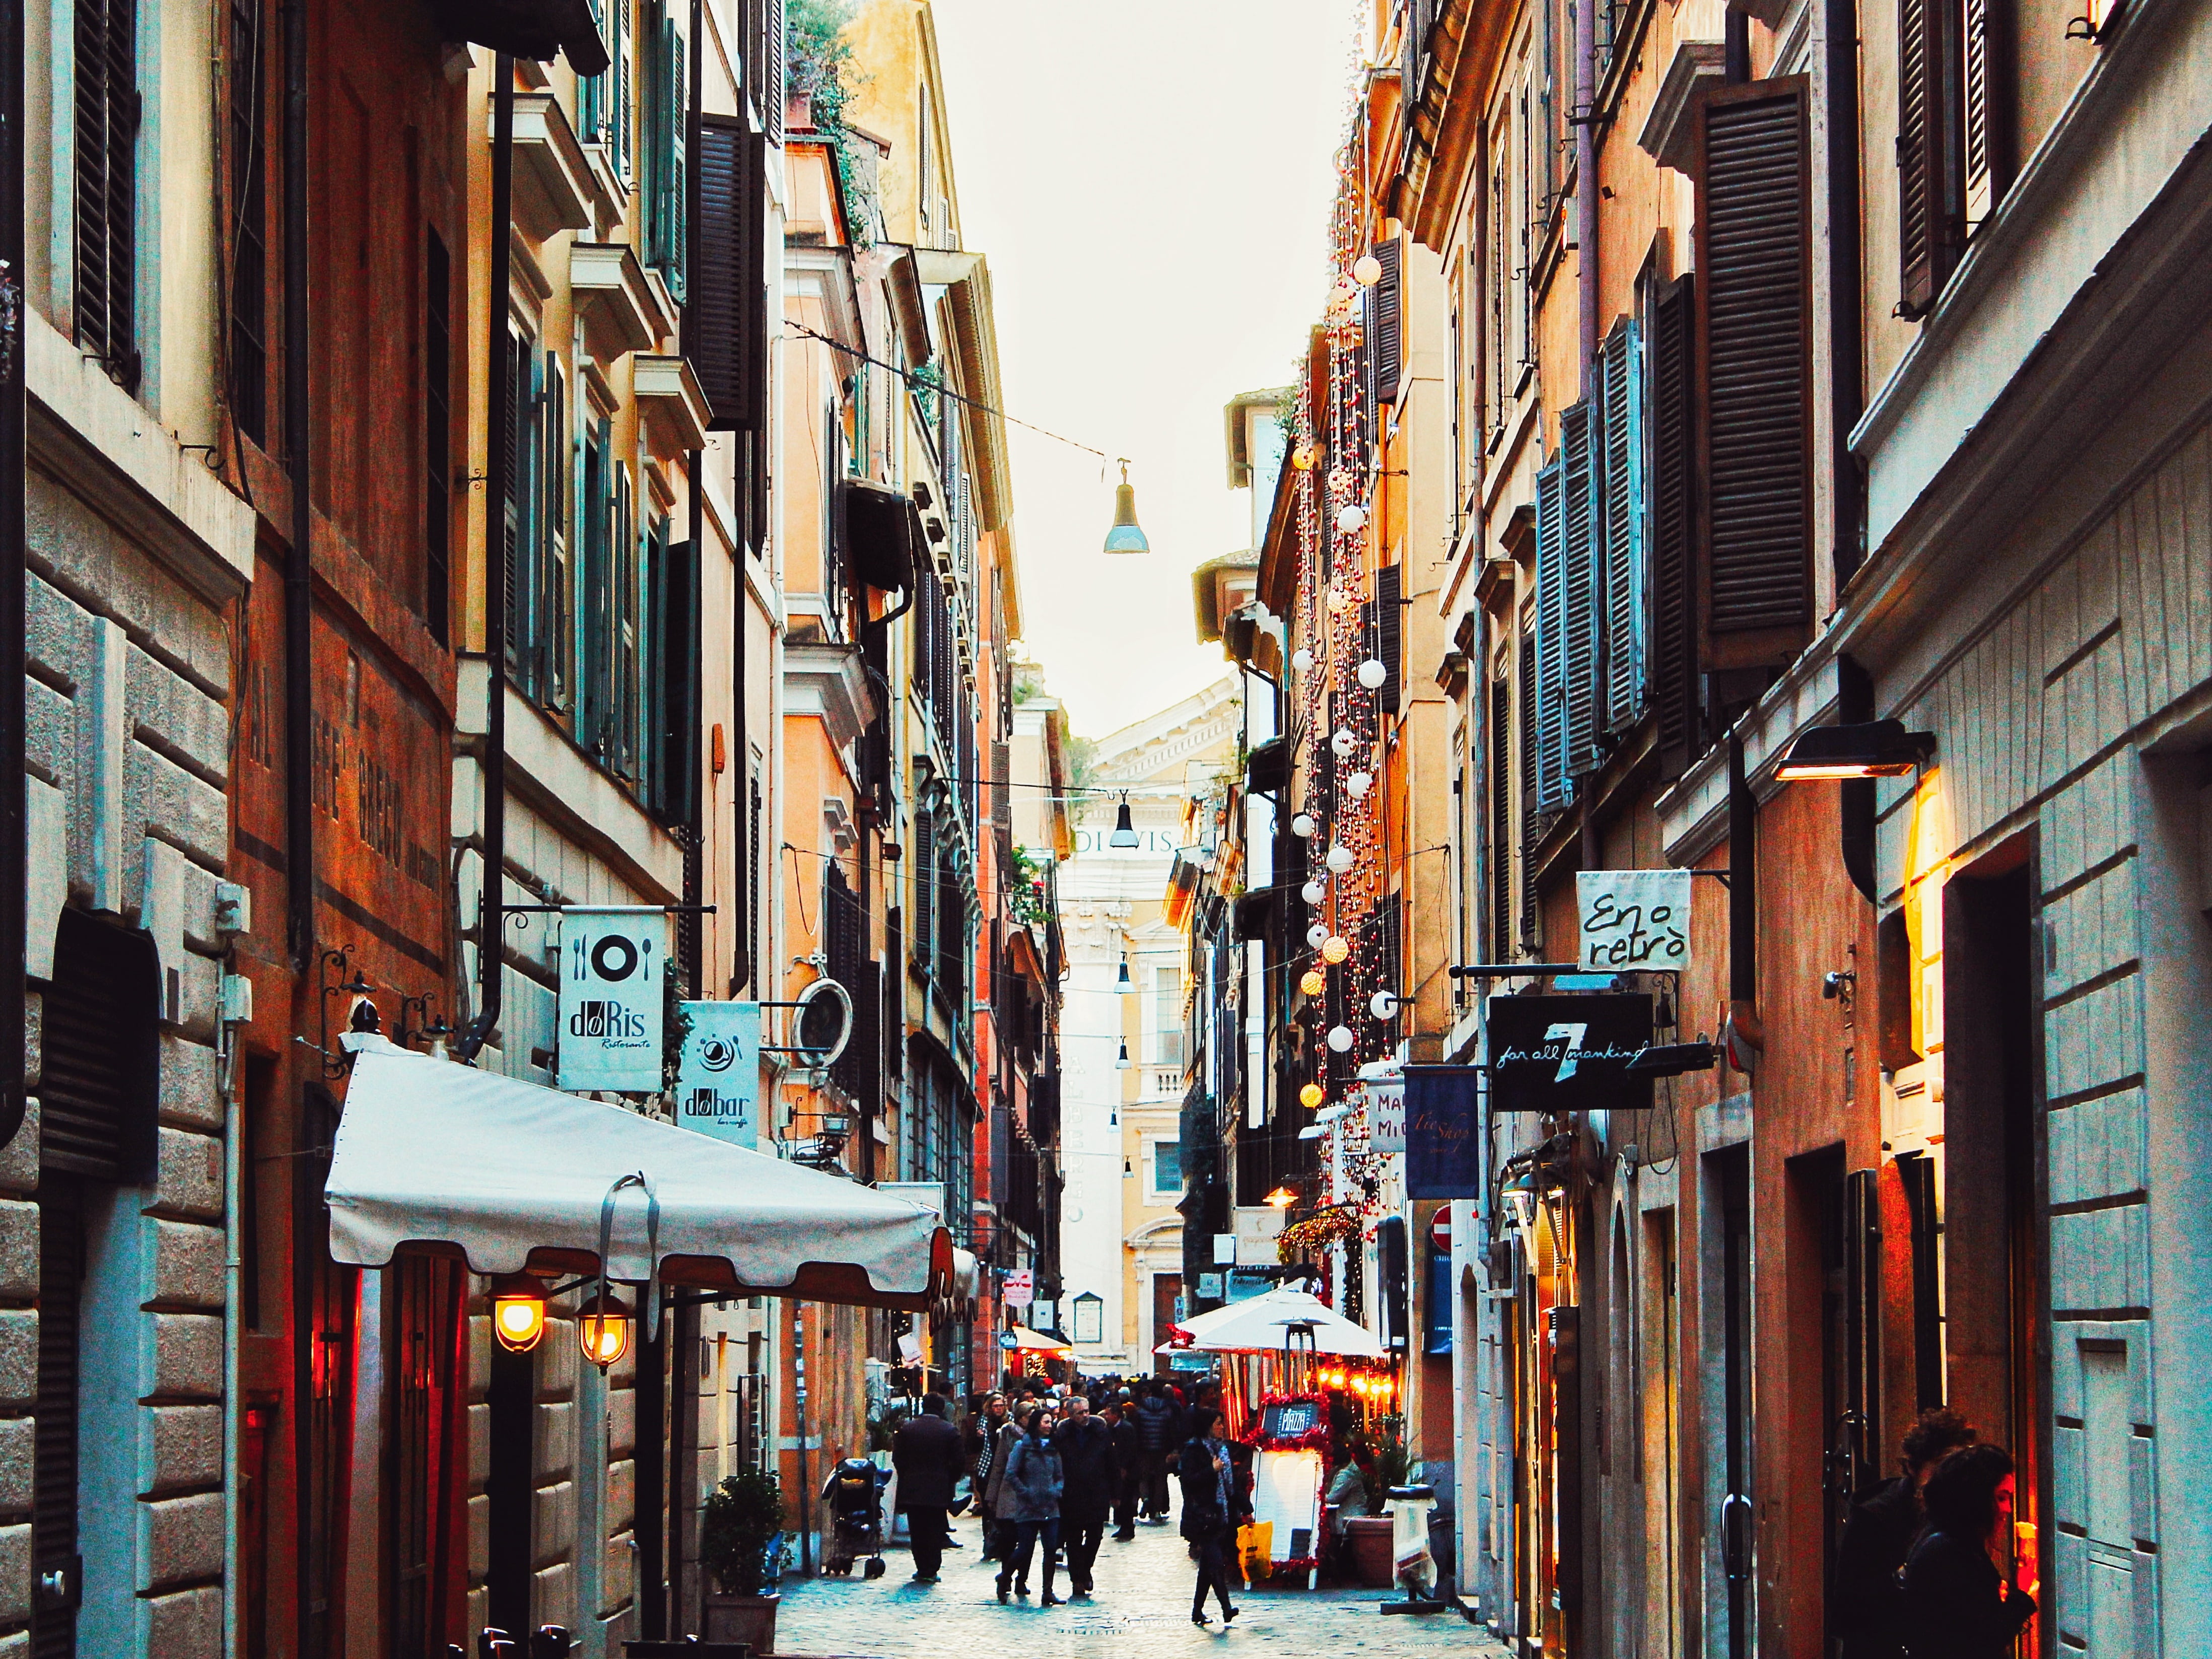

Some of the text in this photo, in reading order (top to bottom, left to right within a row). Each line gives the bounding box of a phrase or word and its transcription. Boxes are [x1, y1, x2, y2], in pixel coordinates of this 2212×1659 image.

[1583, 893, 1671, 932] Eno
[1589, 926, 1685, 965] retrò
[601, 1038, 651, 1049] Ristorante
[1496, 1040, 1648, 1069] for all mankind
[1543, 1023, 1587, 1083] 7
[1065, 1055, 1085, 1224] ALBERGO
[1281, 1408, 1306, 1431] PIAZZA
